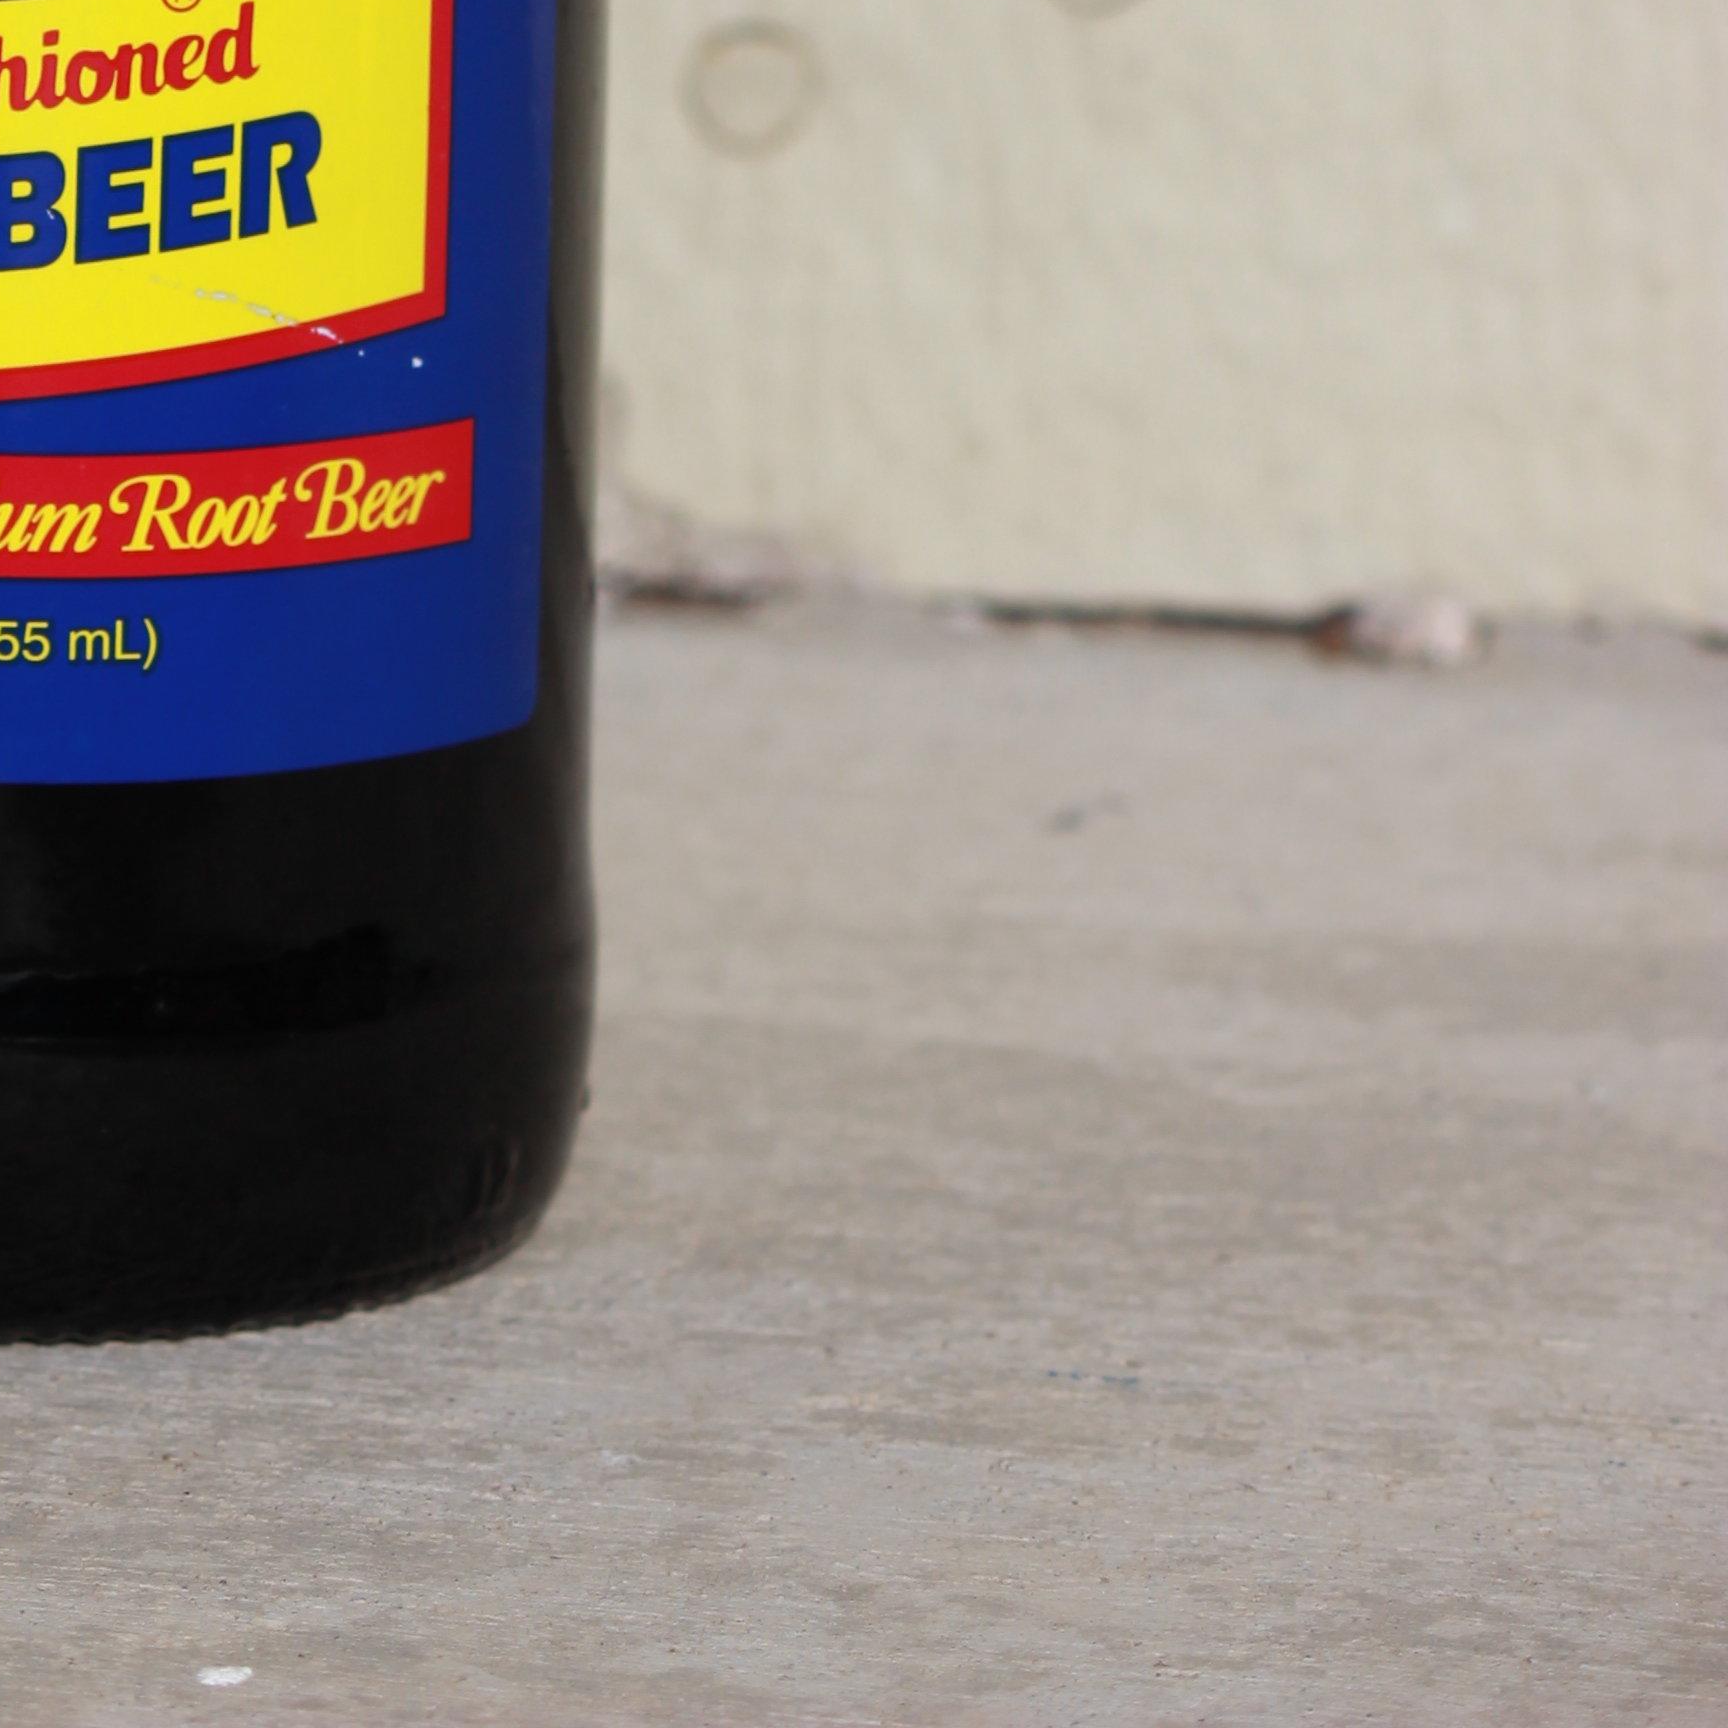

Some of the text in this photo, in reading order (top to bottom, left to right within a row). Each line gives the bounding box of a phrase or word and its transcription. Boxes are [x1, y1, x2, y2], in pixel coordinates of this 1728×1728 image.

[108, 473, 288, 553] Root
[293, 457, 446, 540] Beer
[67, 617, 159, 670] mL)
